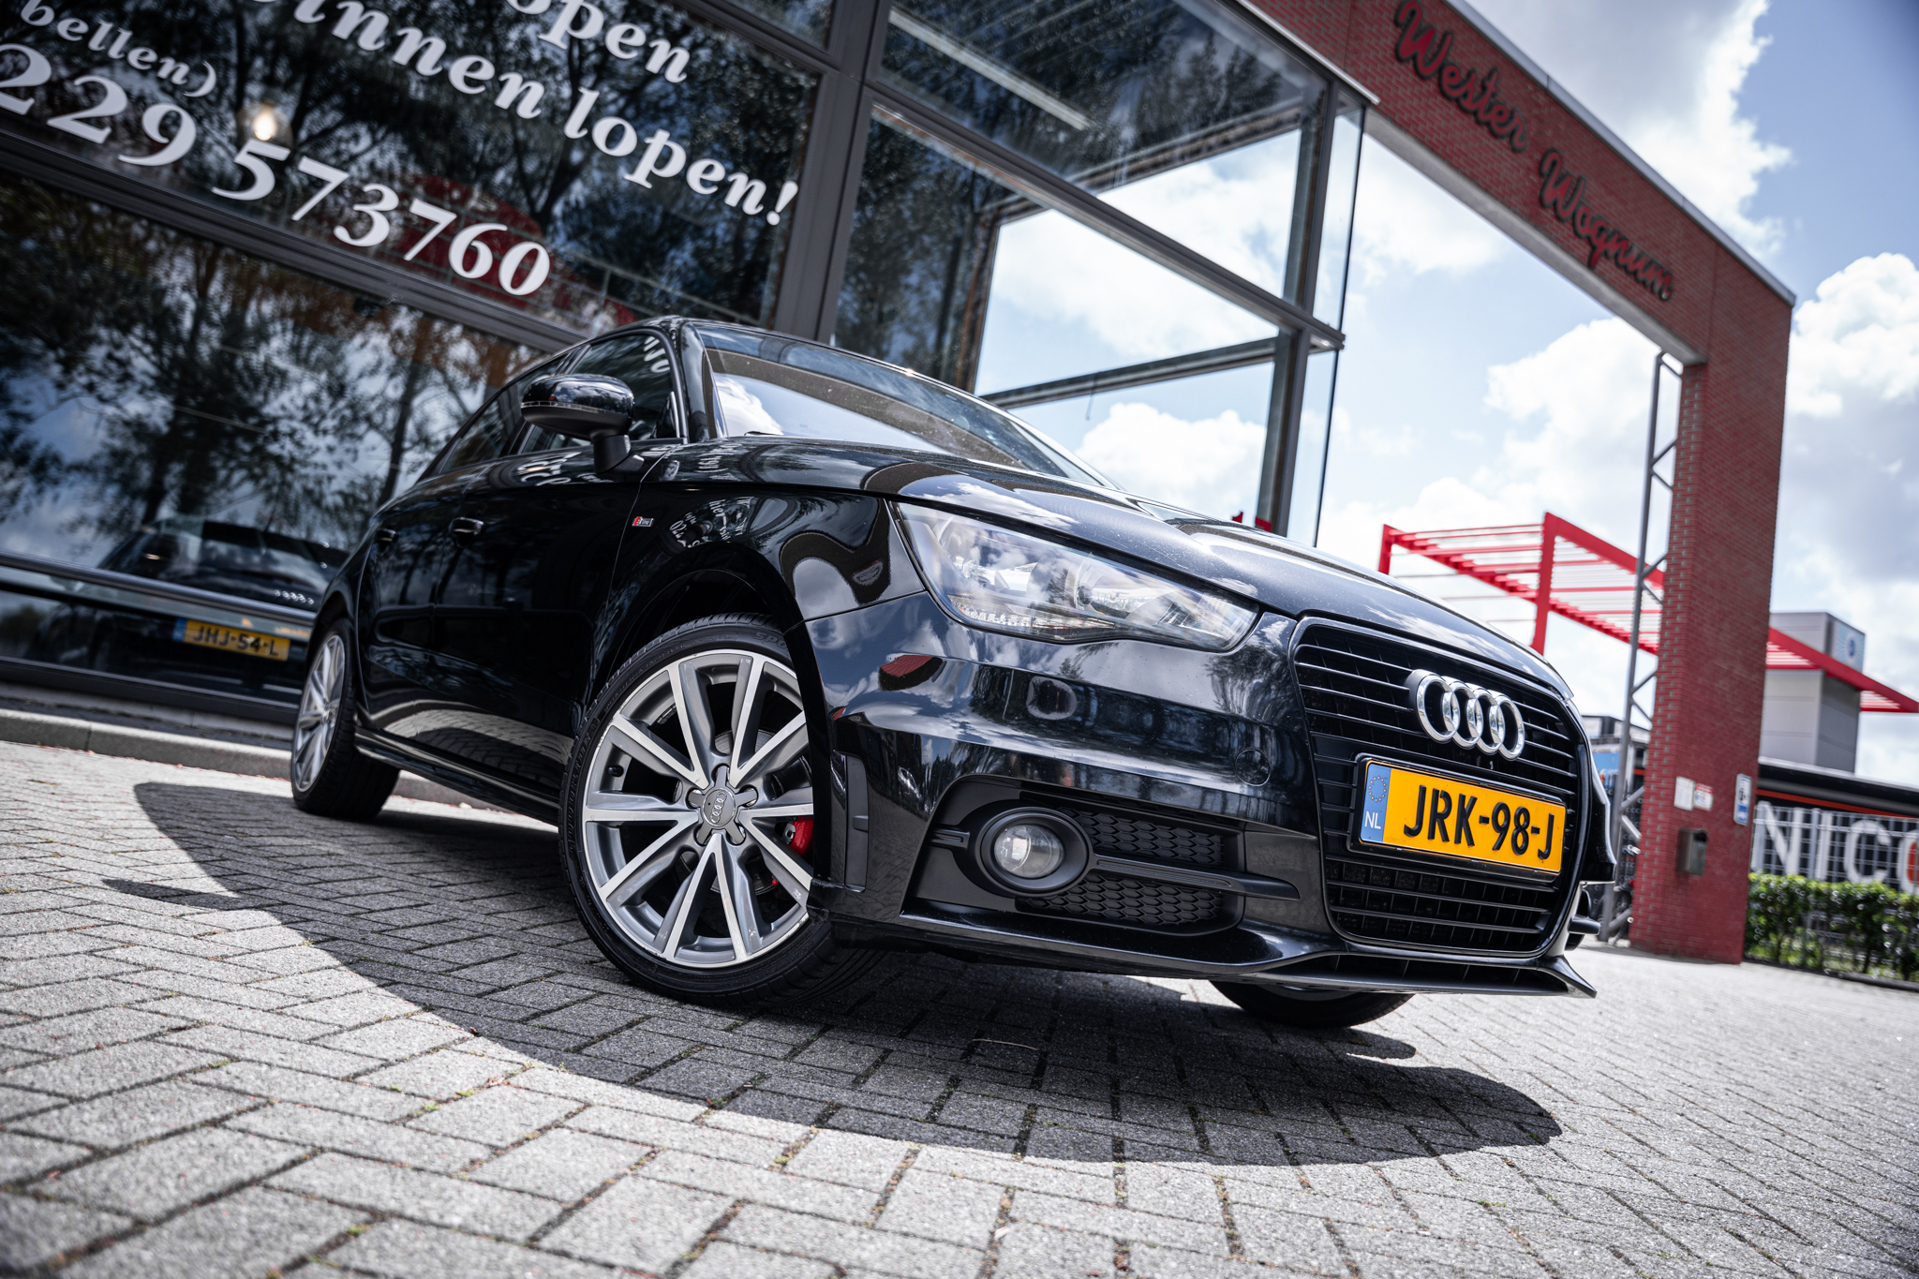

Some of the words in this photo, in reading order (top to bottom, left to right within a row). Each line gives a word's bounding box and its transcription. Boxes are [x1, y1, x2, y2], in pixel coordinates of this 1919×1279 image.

[20, 0, 217, 97] bellen)
[1394, 0, 1527, 152] Wester
[251, 0, 545, 119] nnen
[563, 87, 799, 226] lopen!
[211, 138, 550, 296] 573760
[1364, 811, 1381, 831] NL
[1403, 784, 1555, 861] JRK-98-J
